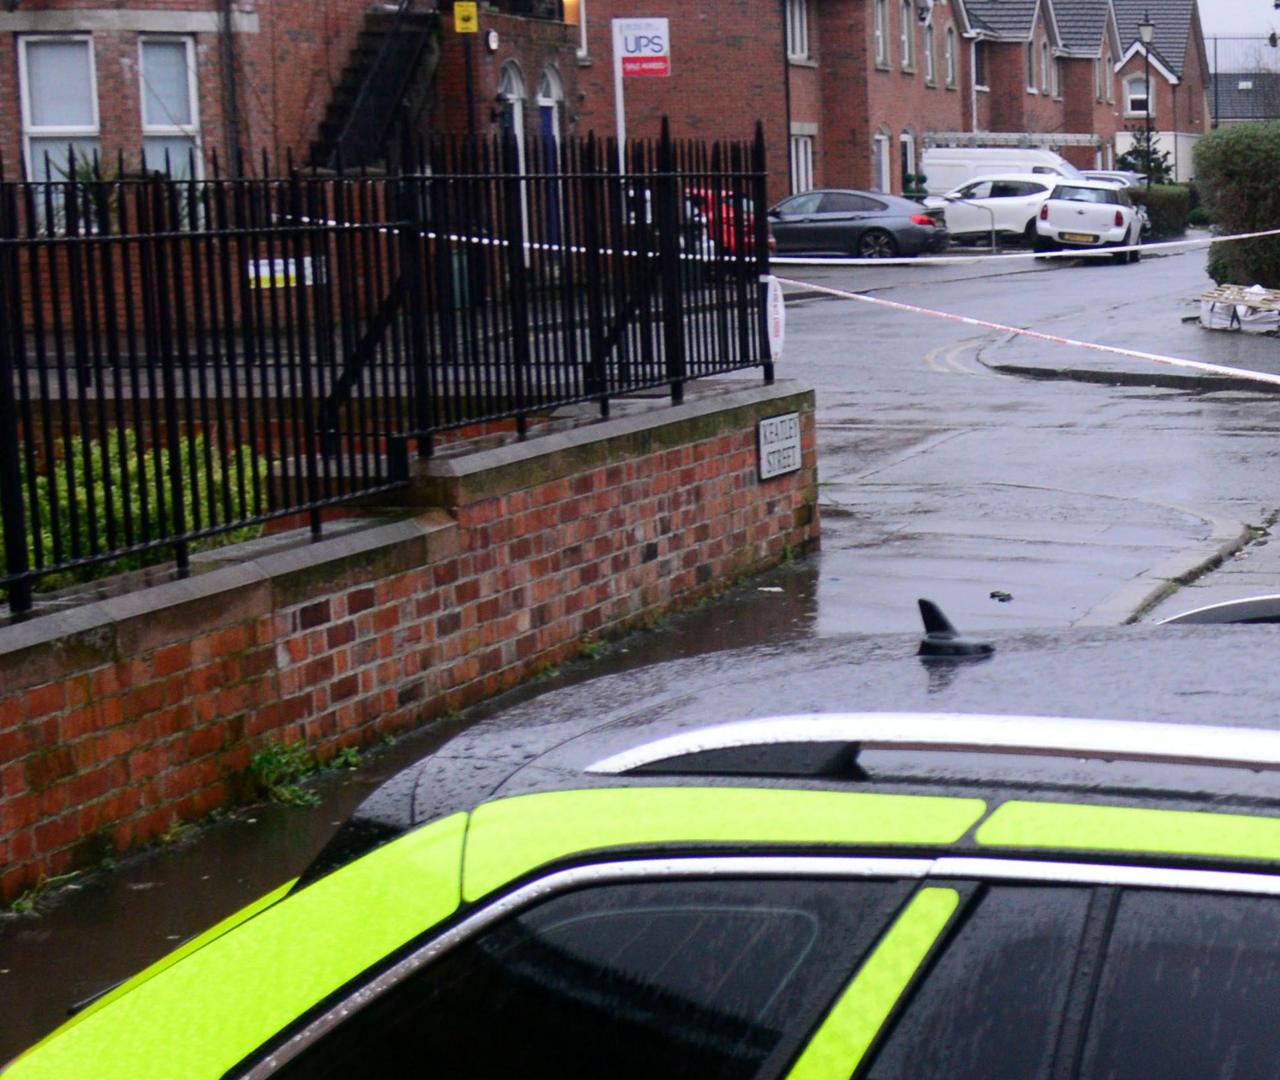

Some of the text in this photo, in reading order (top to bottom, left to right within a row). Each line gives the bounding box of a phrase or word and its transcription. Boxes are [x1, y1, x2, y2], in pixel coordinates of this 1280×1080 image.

[624, 35, 664, 54] UPS
[762, 417, 798, 446] KEATLEY
[766, 445, 797, 474] STREET
